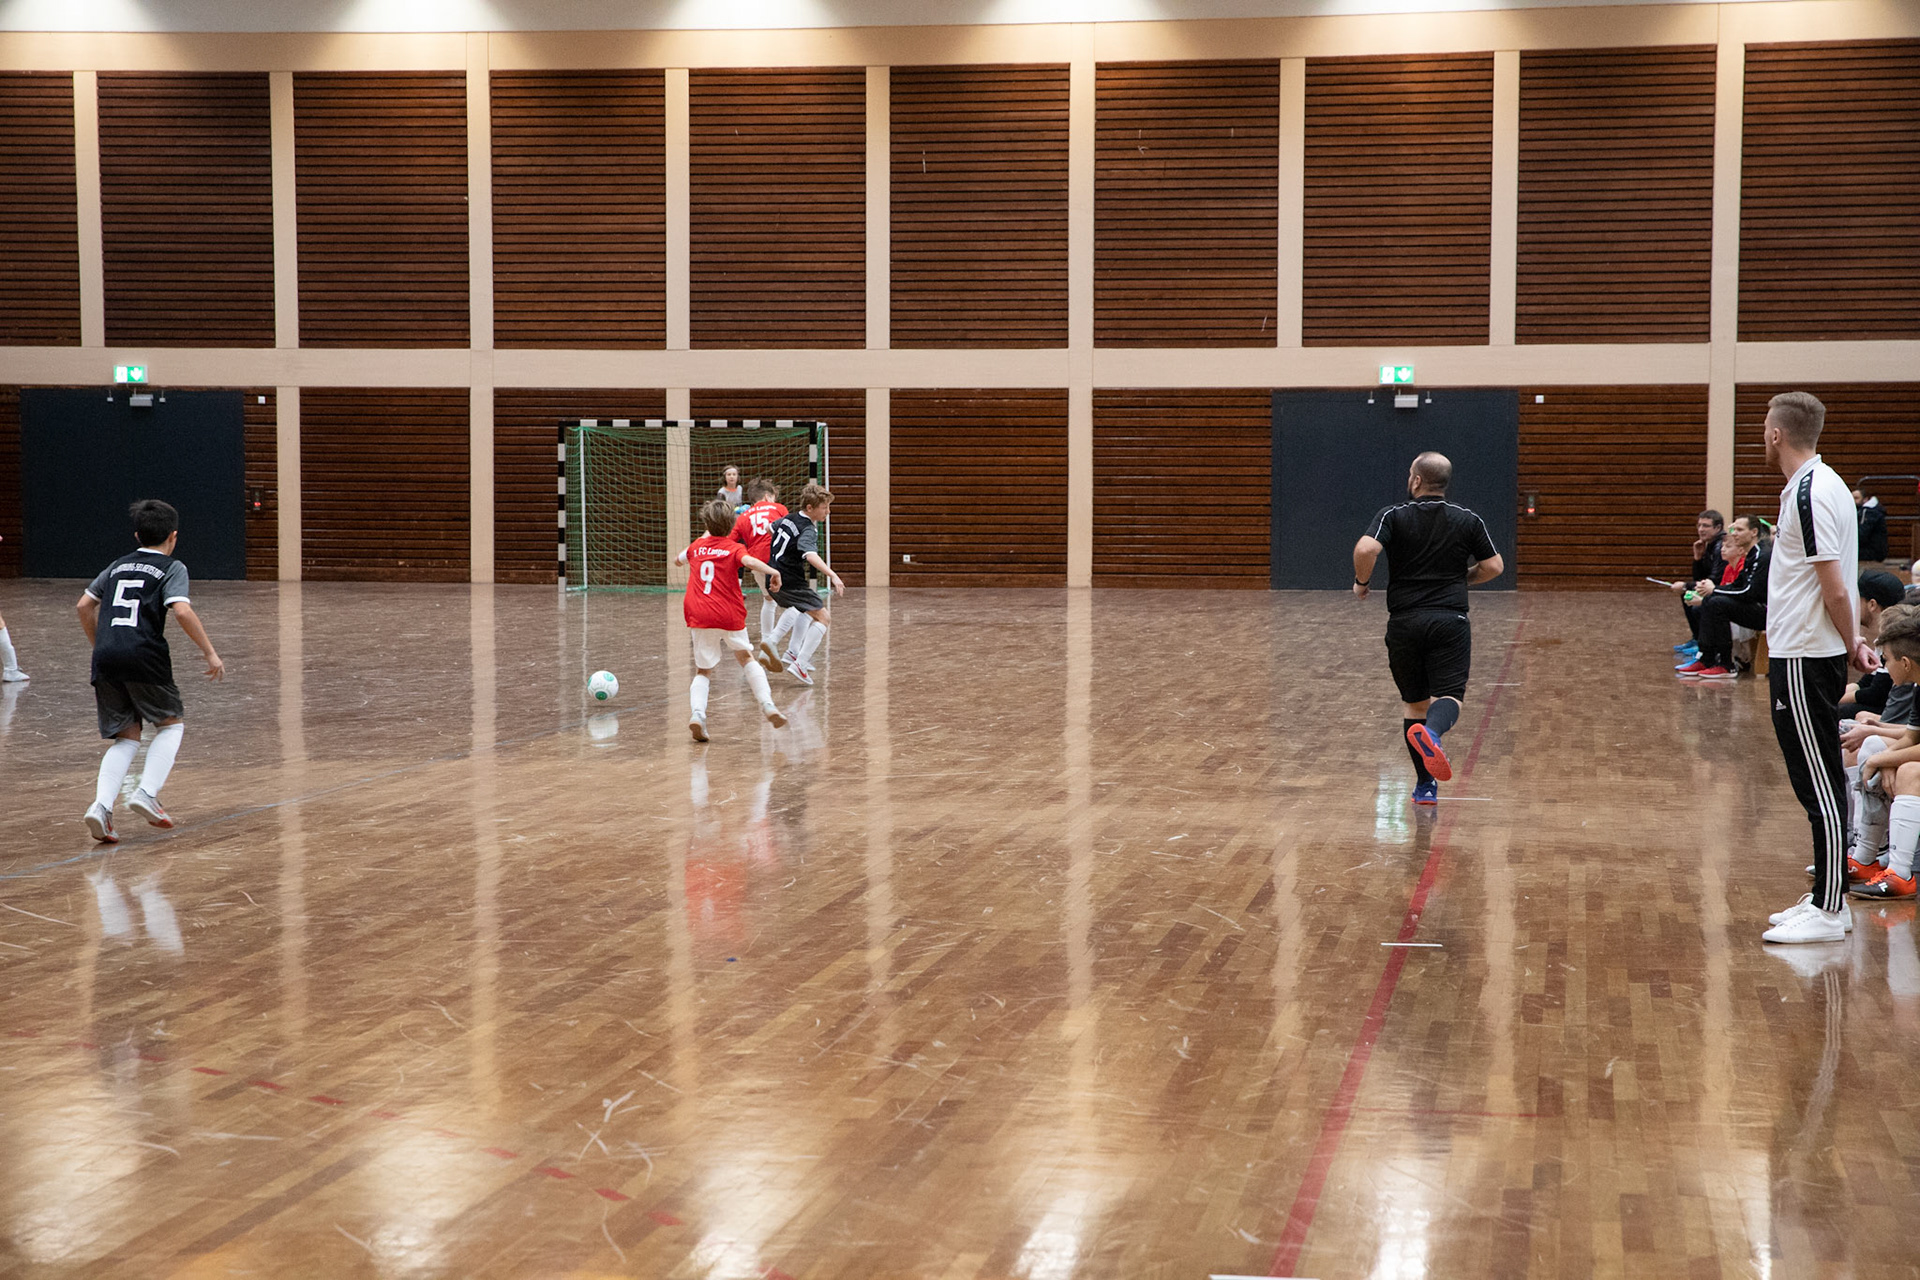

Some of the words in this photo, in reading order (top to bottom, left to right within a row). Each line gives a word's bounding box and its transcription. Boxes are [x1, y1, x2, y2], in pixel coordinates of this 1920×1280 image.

[749, 511, 770, 537] 15
[698, 546, 707, 556] FC
[700, 560, 715, 595] 9
[110, 579, 145, 627] 5
